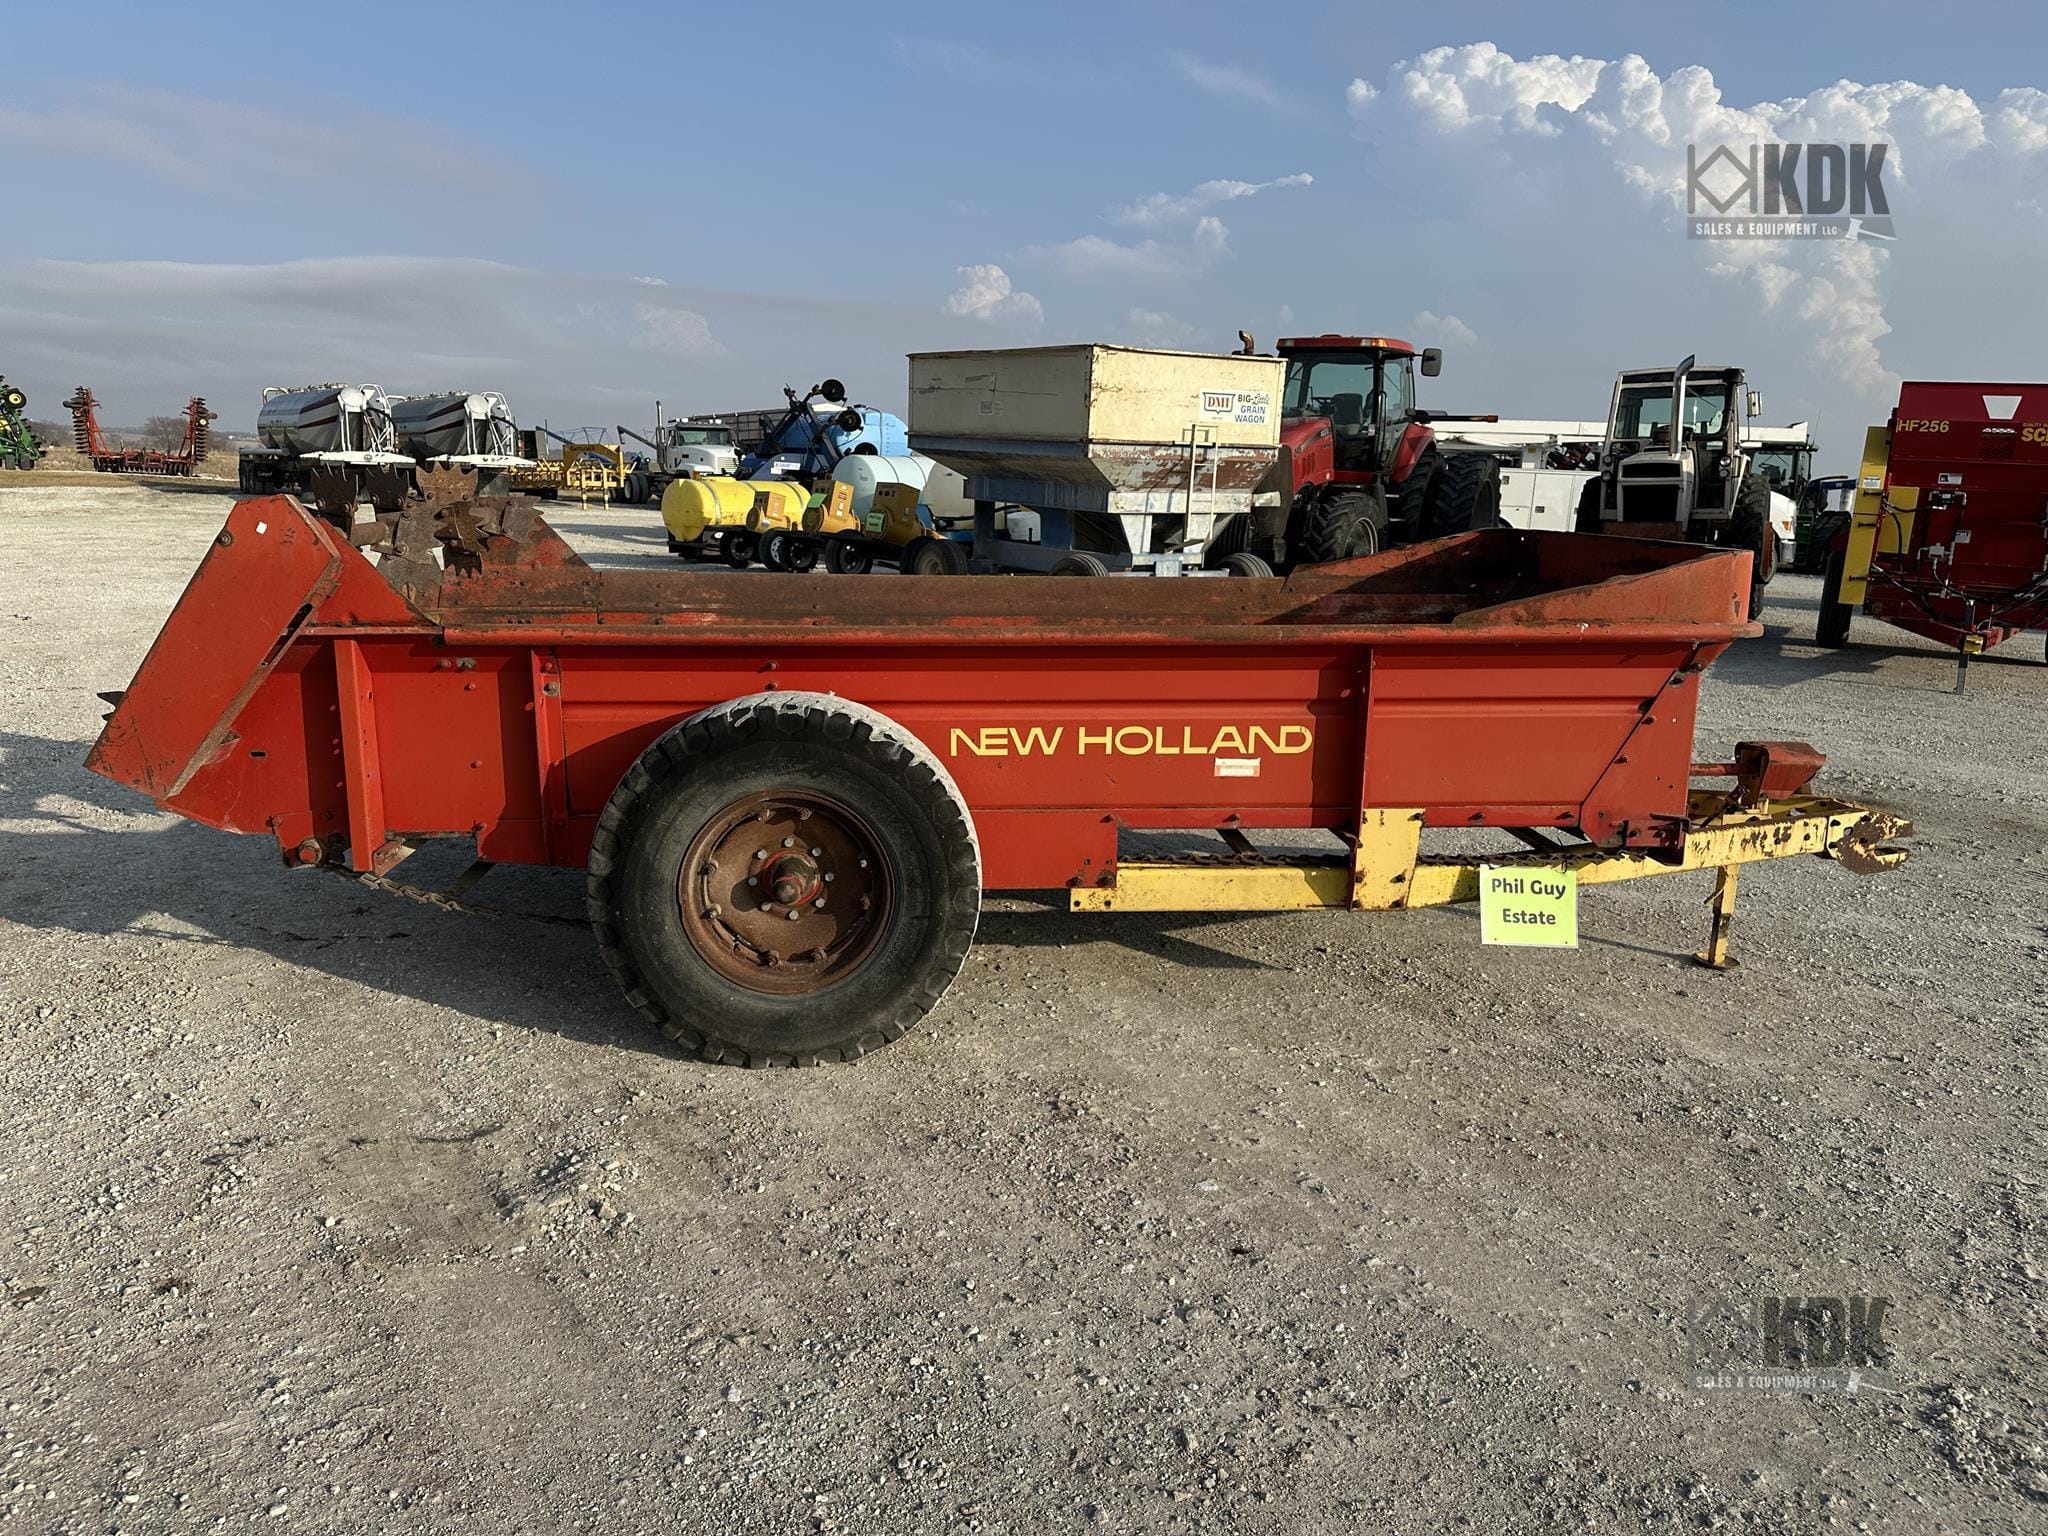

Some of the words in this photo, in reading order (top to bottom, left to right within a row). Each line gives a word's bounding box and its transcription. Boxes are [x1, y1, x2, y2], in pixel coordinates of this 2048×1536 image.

[1208, 396, 1230, 408] DMI
[1240, 405, 1266, 414] GRAIN
[1235, 415, 1265, 424] WAGON
[2021, 427, 2048, 442] SC
[950, 726, 1064, 757] NEW
[1078, 725, 1313, 756] HOLLAND
[1491, 878, 1524, 894] Phil
[1530, 880, 1566, 900] Guy
[1502, 908, 1556, 925] Estate
